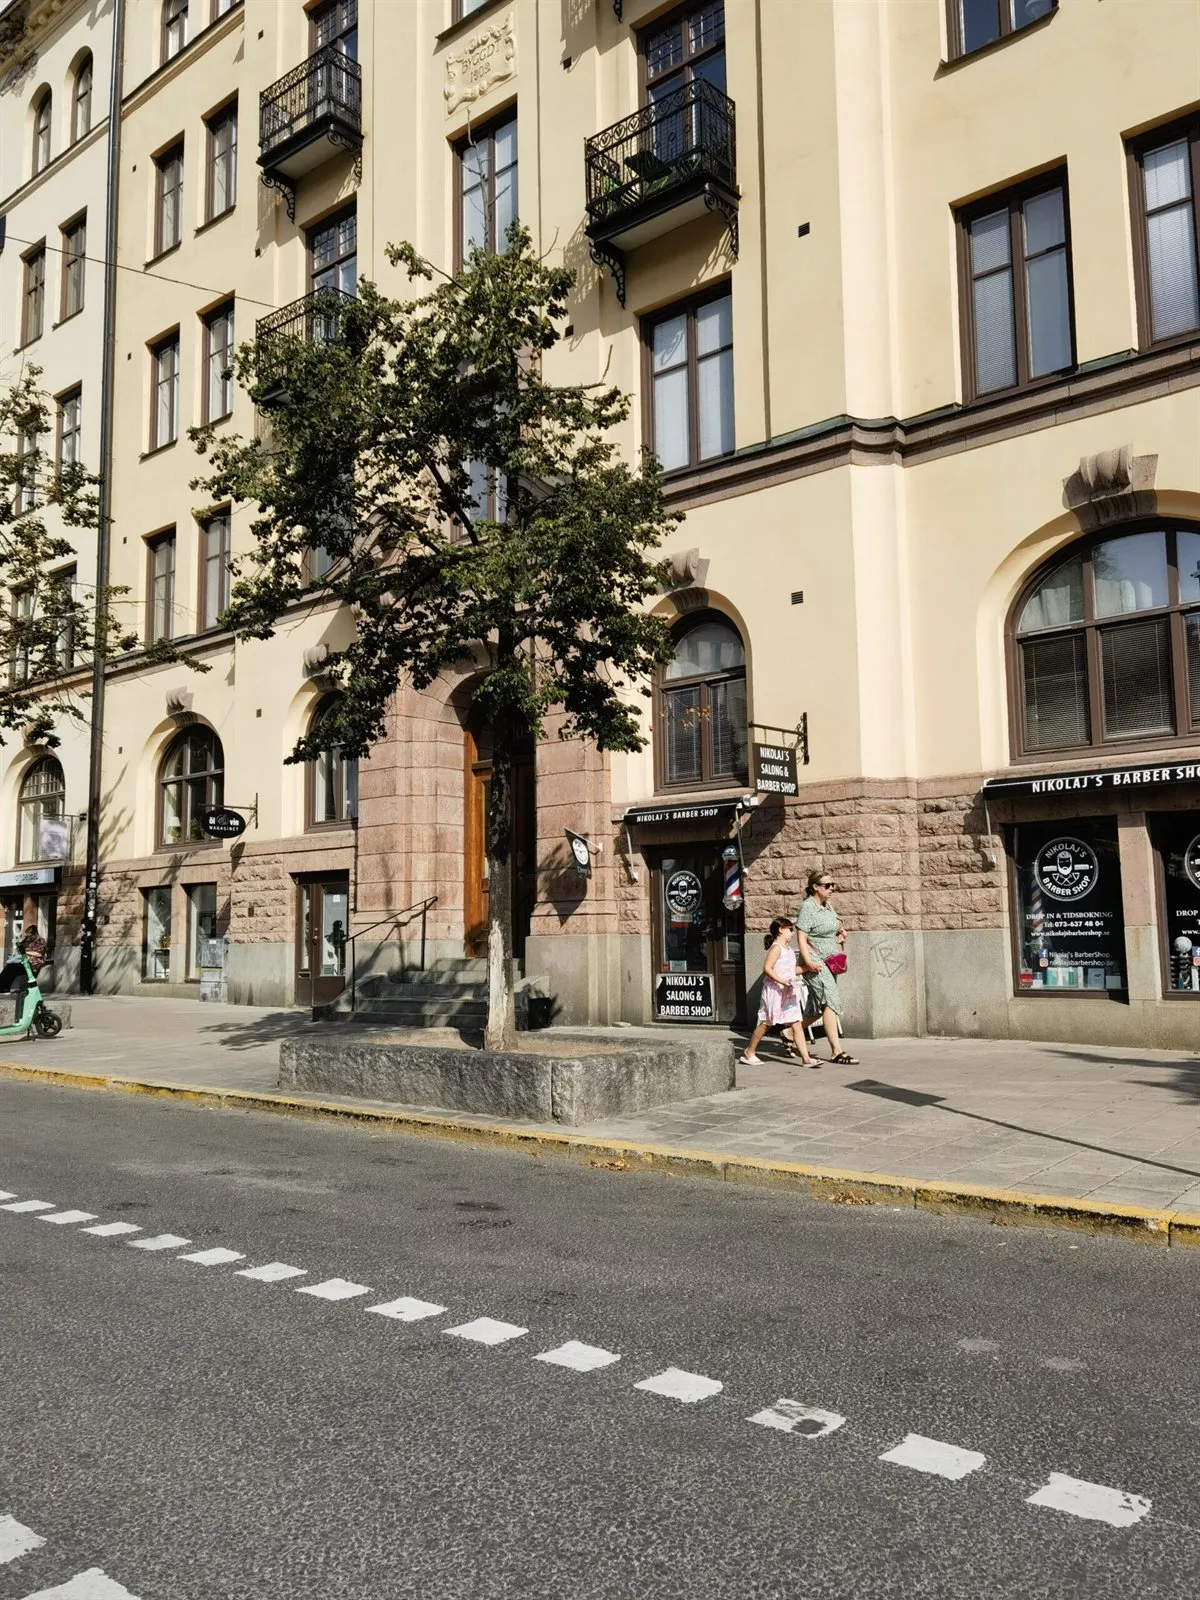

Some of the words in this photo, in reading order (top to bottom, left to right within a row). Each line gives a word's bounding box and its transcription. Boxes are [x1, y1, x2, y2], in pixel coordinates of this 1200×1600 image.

[461, 38, 502, 75] BYGGDT
[760, 763, 784, 777] SALONG
[784, 766, 790, 777] &
[1112, 768, 1171, 786] BARBER
[756, 778, 781, 792] BARBER
[781, 781, 797, 794] SHOP
[672, 810, 699, 820] BARBER
[700, 808, 719, 817] SHOP
[1042, 877, 1072, 896] BARBER
[1071, 875, 1091, 895] SHOP
[1062, 911, 1113, 919] TIDSBOKNING
[1176, 909, 1199, 920] DROP
[1054, 920, 1083, 928] 073-637
[666, 990, 695, 1001] SALONG
[696, 990, 703, 1001] &
[660, 1004, 690, 1016] BARBER
[690, 1005, 711, 1016] SHOP
